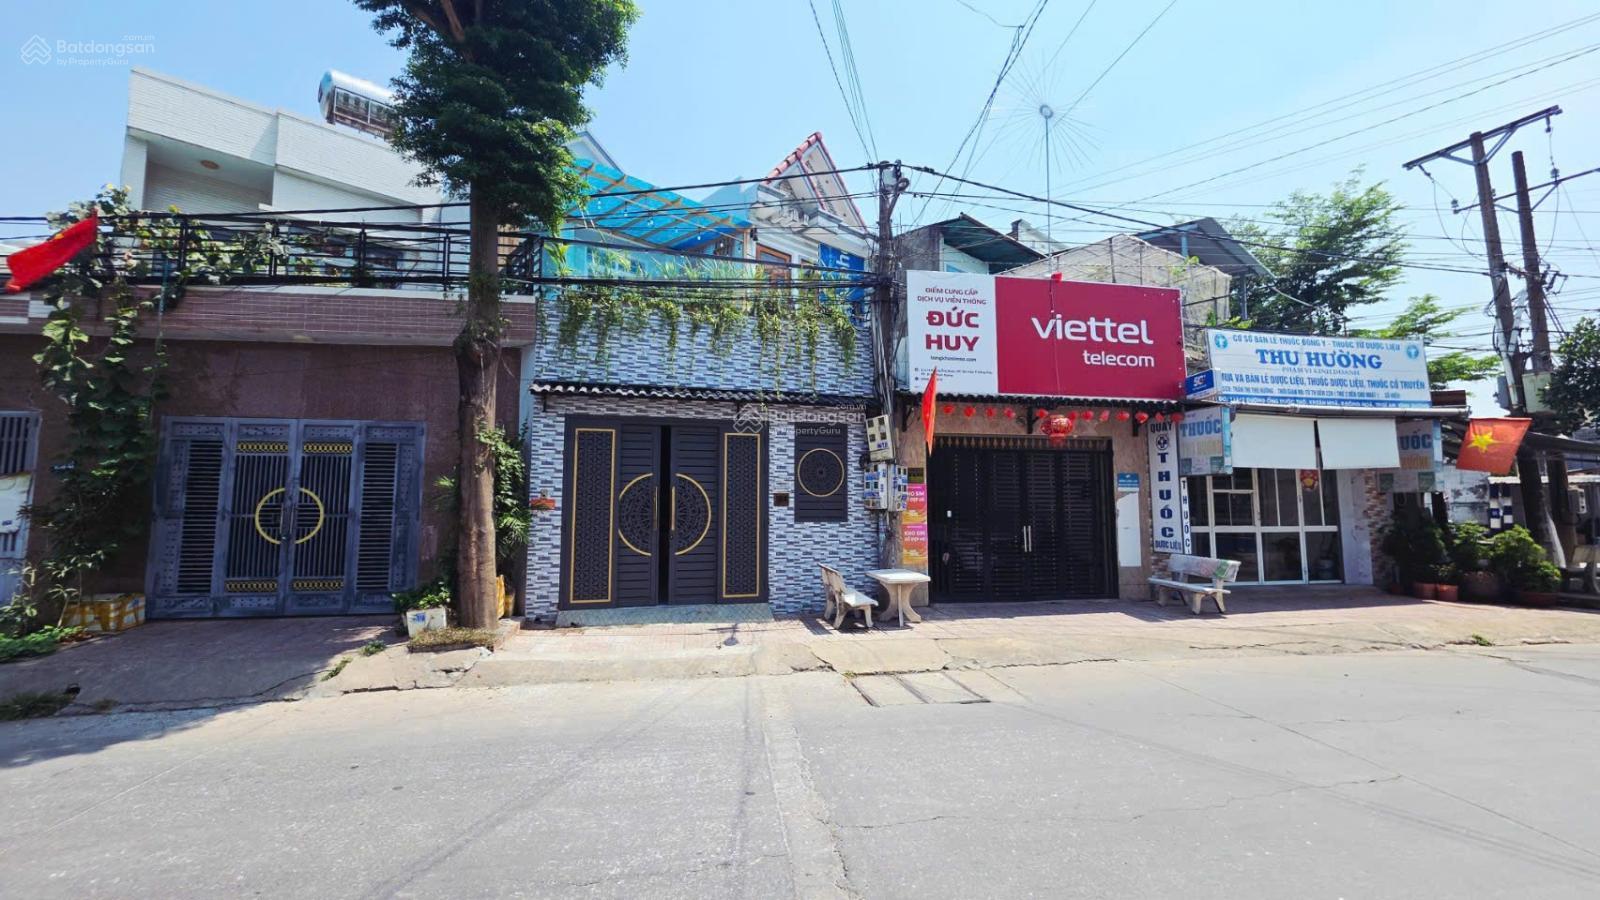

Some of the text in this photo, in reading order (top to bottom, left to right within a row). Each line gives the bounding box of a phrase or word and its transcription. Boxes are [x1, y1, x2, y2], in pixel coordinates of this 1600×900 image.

[917, 295, 933, 303] DỊCH
[926, 306, 979, 328] ĐỨC
[1031, 313, 1154, 345] viettel
[925, 334, 980, 351] HUY
[1279, 336, 1301, 346] THUỐC
[1332, 340, 1354, 349] THUỐC
[1082, 350, 1155, 367] telecom
[1255, 348, 1383, 370] THU HƯỜNG
[1180, 415, 1221, 438] THUỐC
[1157, 453, 1175, 538] THUỐC
